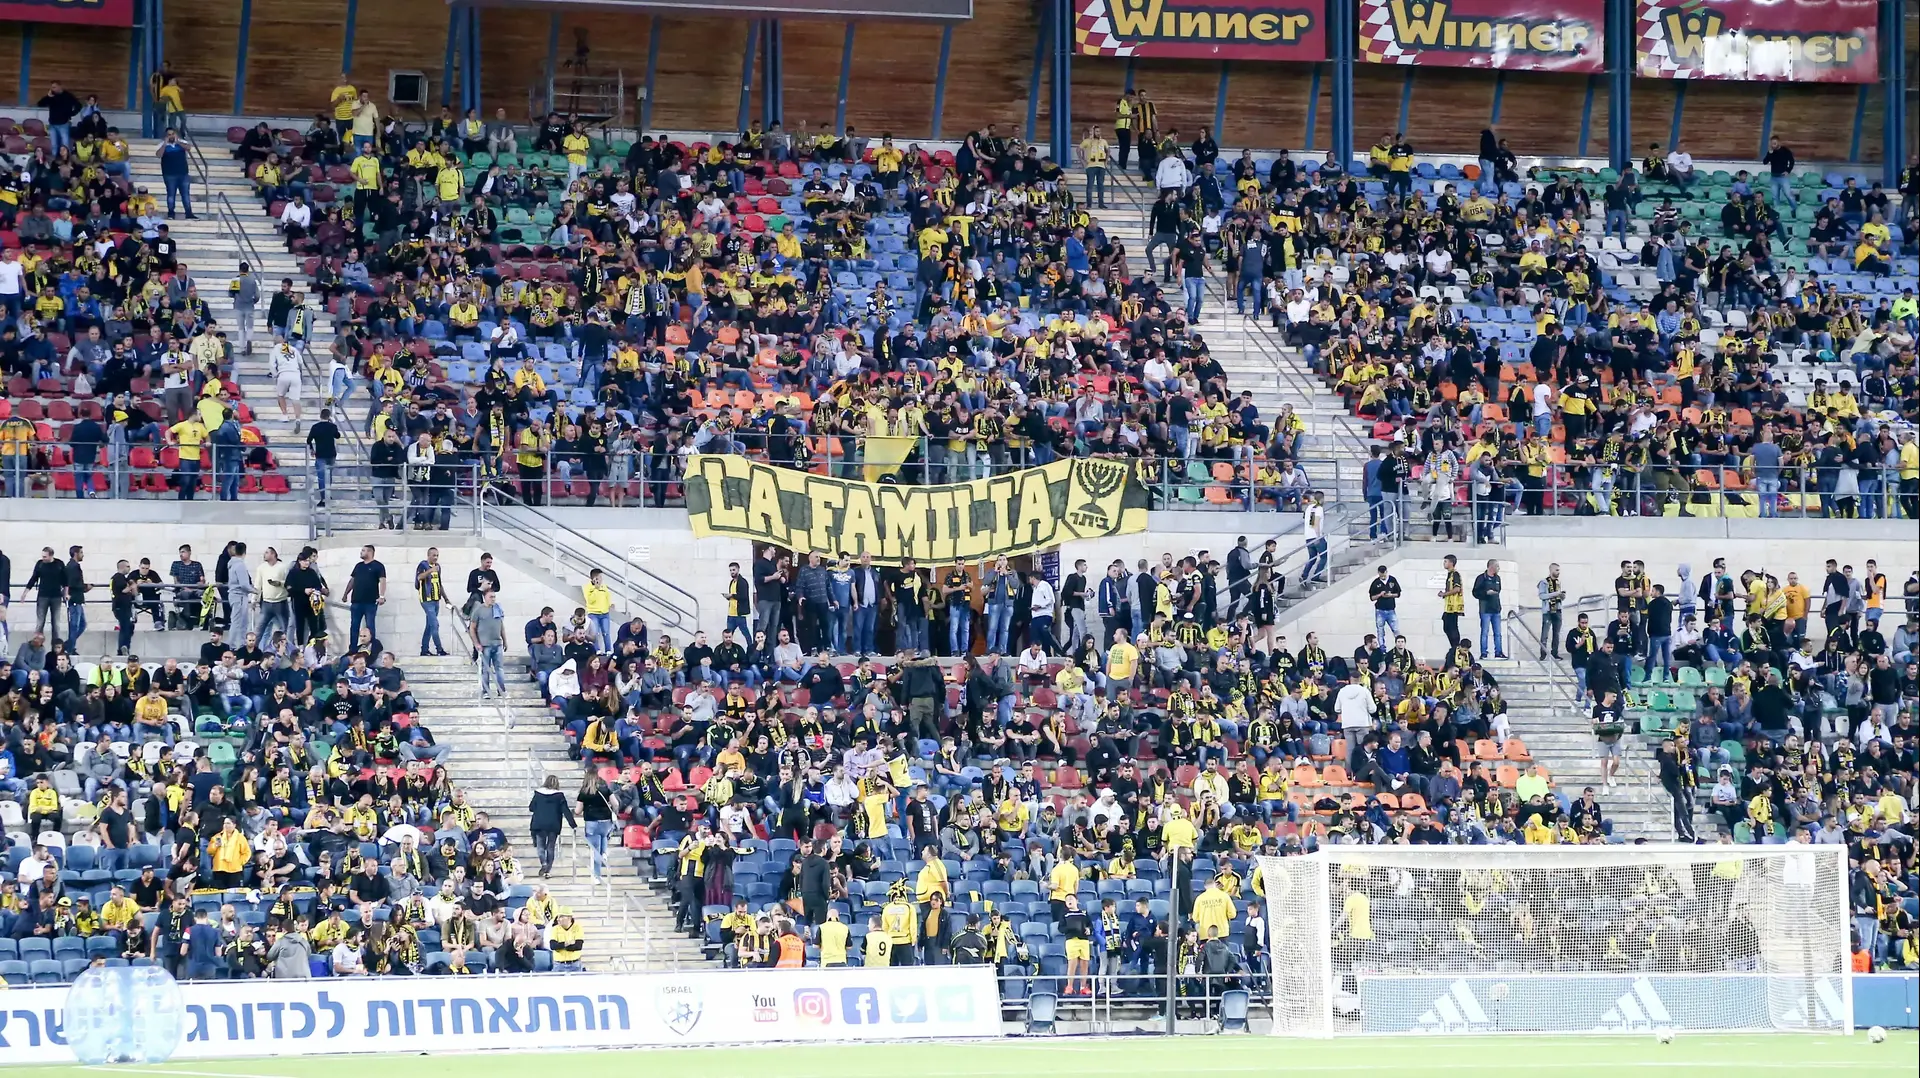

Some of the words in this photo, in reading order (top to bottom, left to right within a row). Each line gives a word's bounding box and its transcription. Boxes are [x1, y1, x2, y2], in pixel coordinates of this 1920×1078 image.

[1110, 0, 1310, 41] Winner
[1390, 0, 1588, 52] Winner
[1666, 13, 1862, 63] Wner
[700, 457, 793, 545] LA
[804, 469, 1057, 558] FAMILIA
[1069, 512, 1110, 531] ביתר
[878, 941, 886, 956] 9
[662, 986, 692, 994] ISRAEL
[752, 994, 776, 1007] You
[186, 991, 345, 1042] לכדורג
[364, 995, 629, 1037] ההתאחדות
[754, 1010, 777, 1021] Tube
